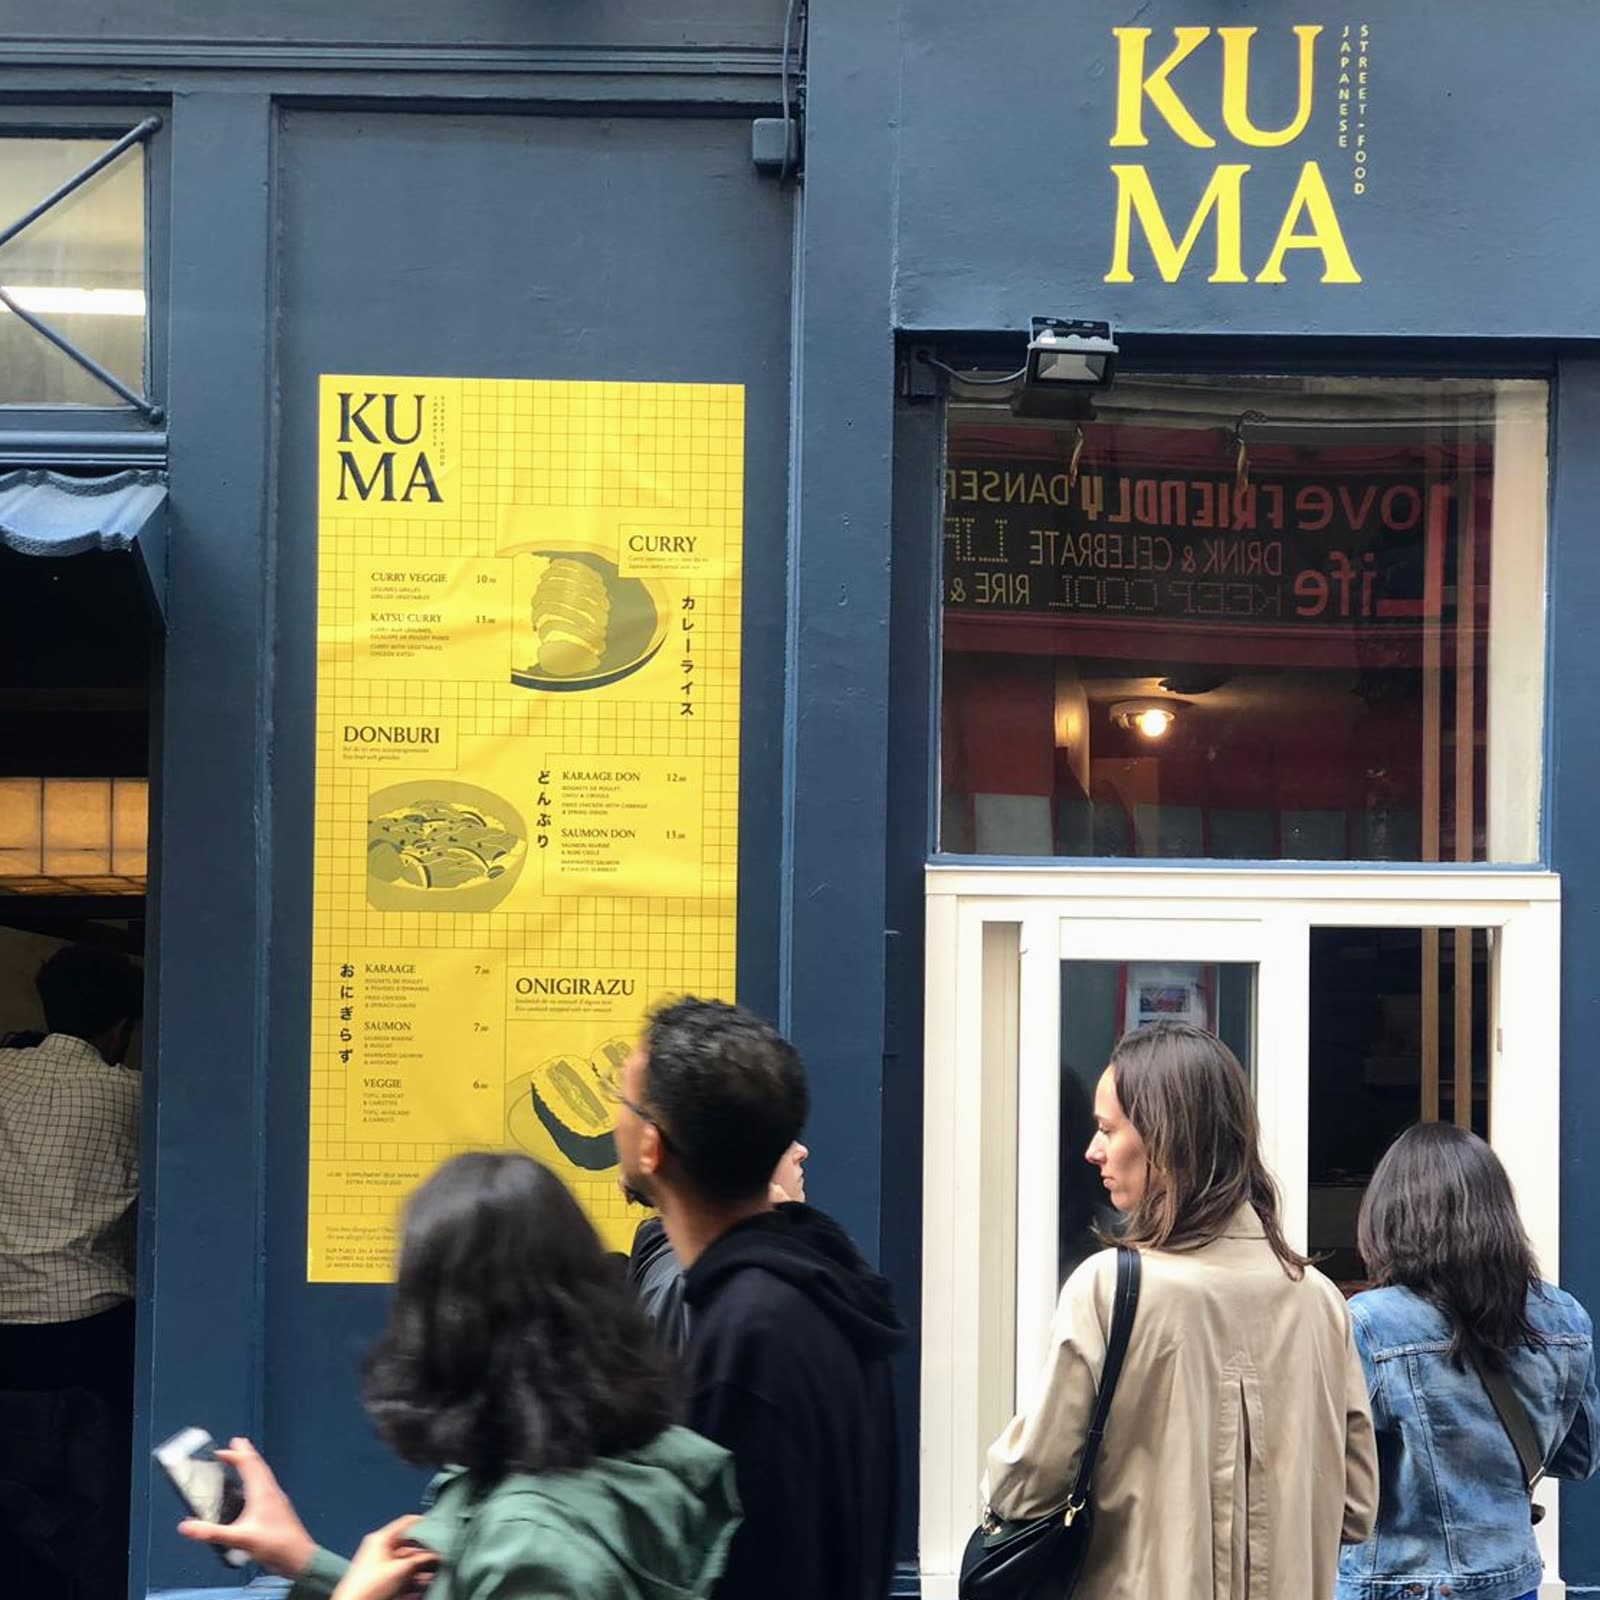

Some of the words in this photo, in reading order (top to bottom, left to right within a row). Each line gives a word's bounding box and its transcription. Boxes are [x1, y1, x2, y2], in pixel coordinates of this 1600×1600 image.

[1109, 25, 1324, 148] KU
[1338, 25, 1351, 148] JAPANESE
[1354, 25, 1369, 195] STREET-FOOD
[1103, 161, 1363, 284] MA
[337, 392, 426, 445] KU
[336, 451, 445, 503] MA
[629, 535, 698, 553] CURRY
[370, 572, 407, 583] CURRY
[409, 573, 449, 583] VEGGIE
[371, 613, 405, 623] KATSU
[407, 614, 443, 624] CURRY
[680, 595, 696, 717] カレーライス
[343, 725, 440, 744] DONBURI
[562, 771, 613, 781] KARAAGE
[615, 772, 641, 782] DON
[536, 770, 552, 849] どんぶり
[561, 828, 608, 838] SAUMON
[611, 829, 636, 839] DON
[364, 963, 417, 974] KARAAGE
[515, 977, 636, 996] ONIGIRAZU
[339, 963, 355, 1064] おにぎらず
[364, 1021, 412, 1031] SAUMON
[363, 1078, 402, 1089] VEGGIE
